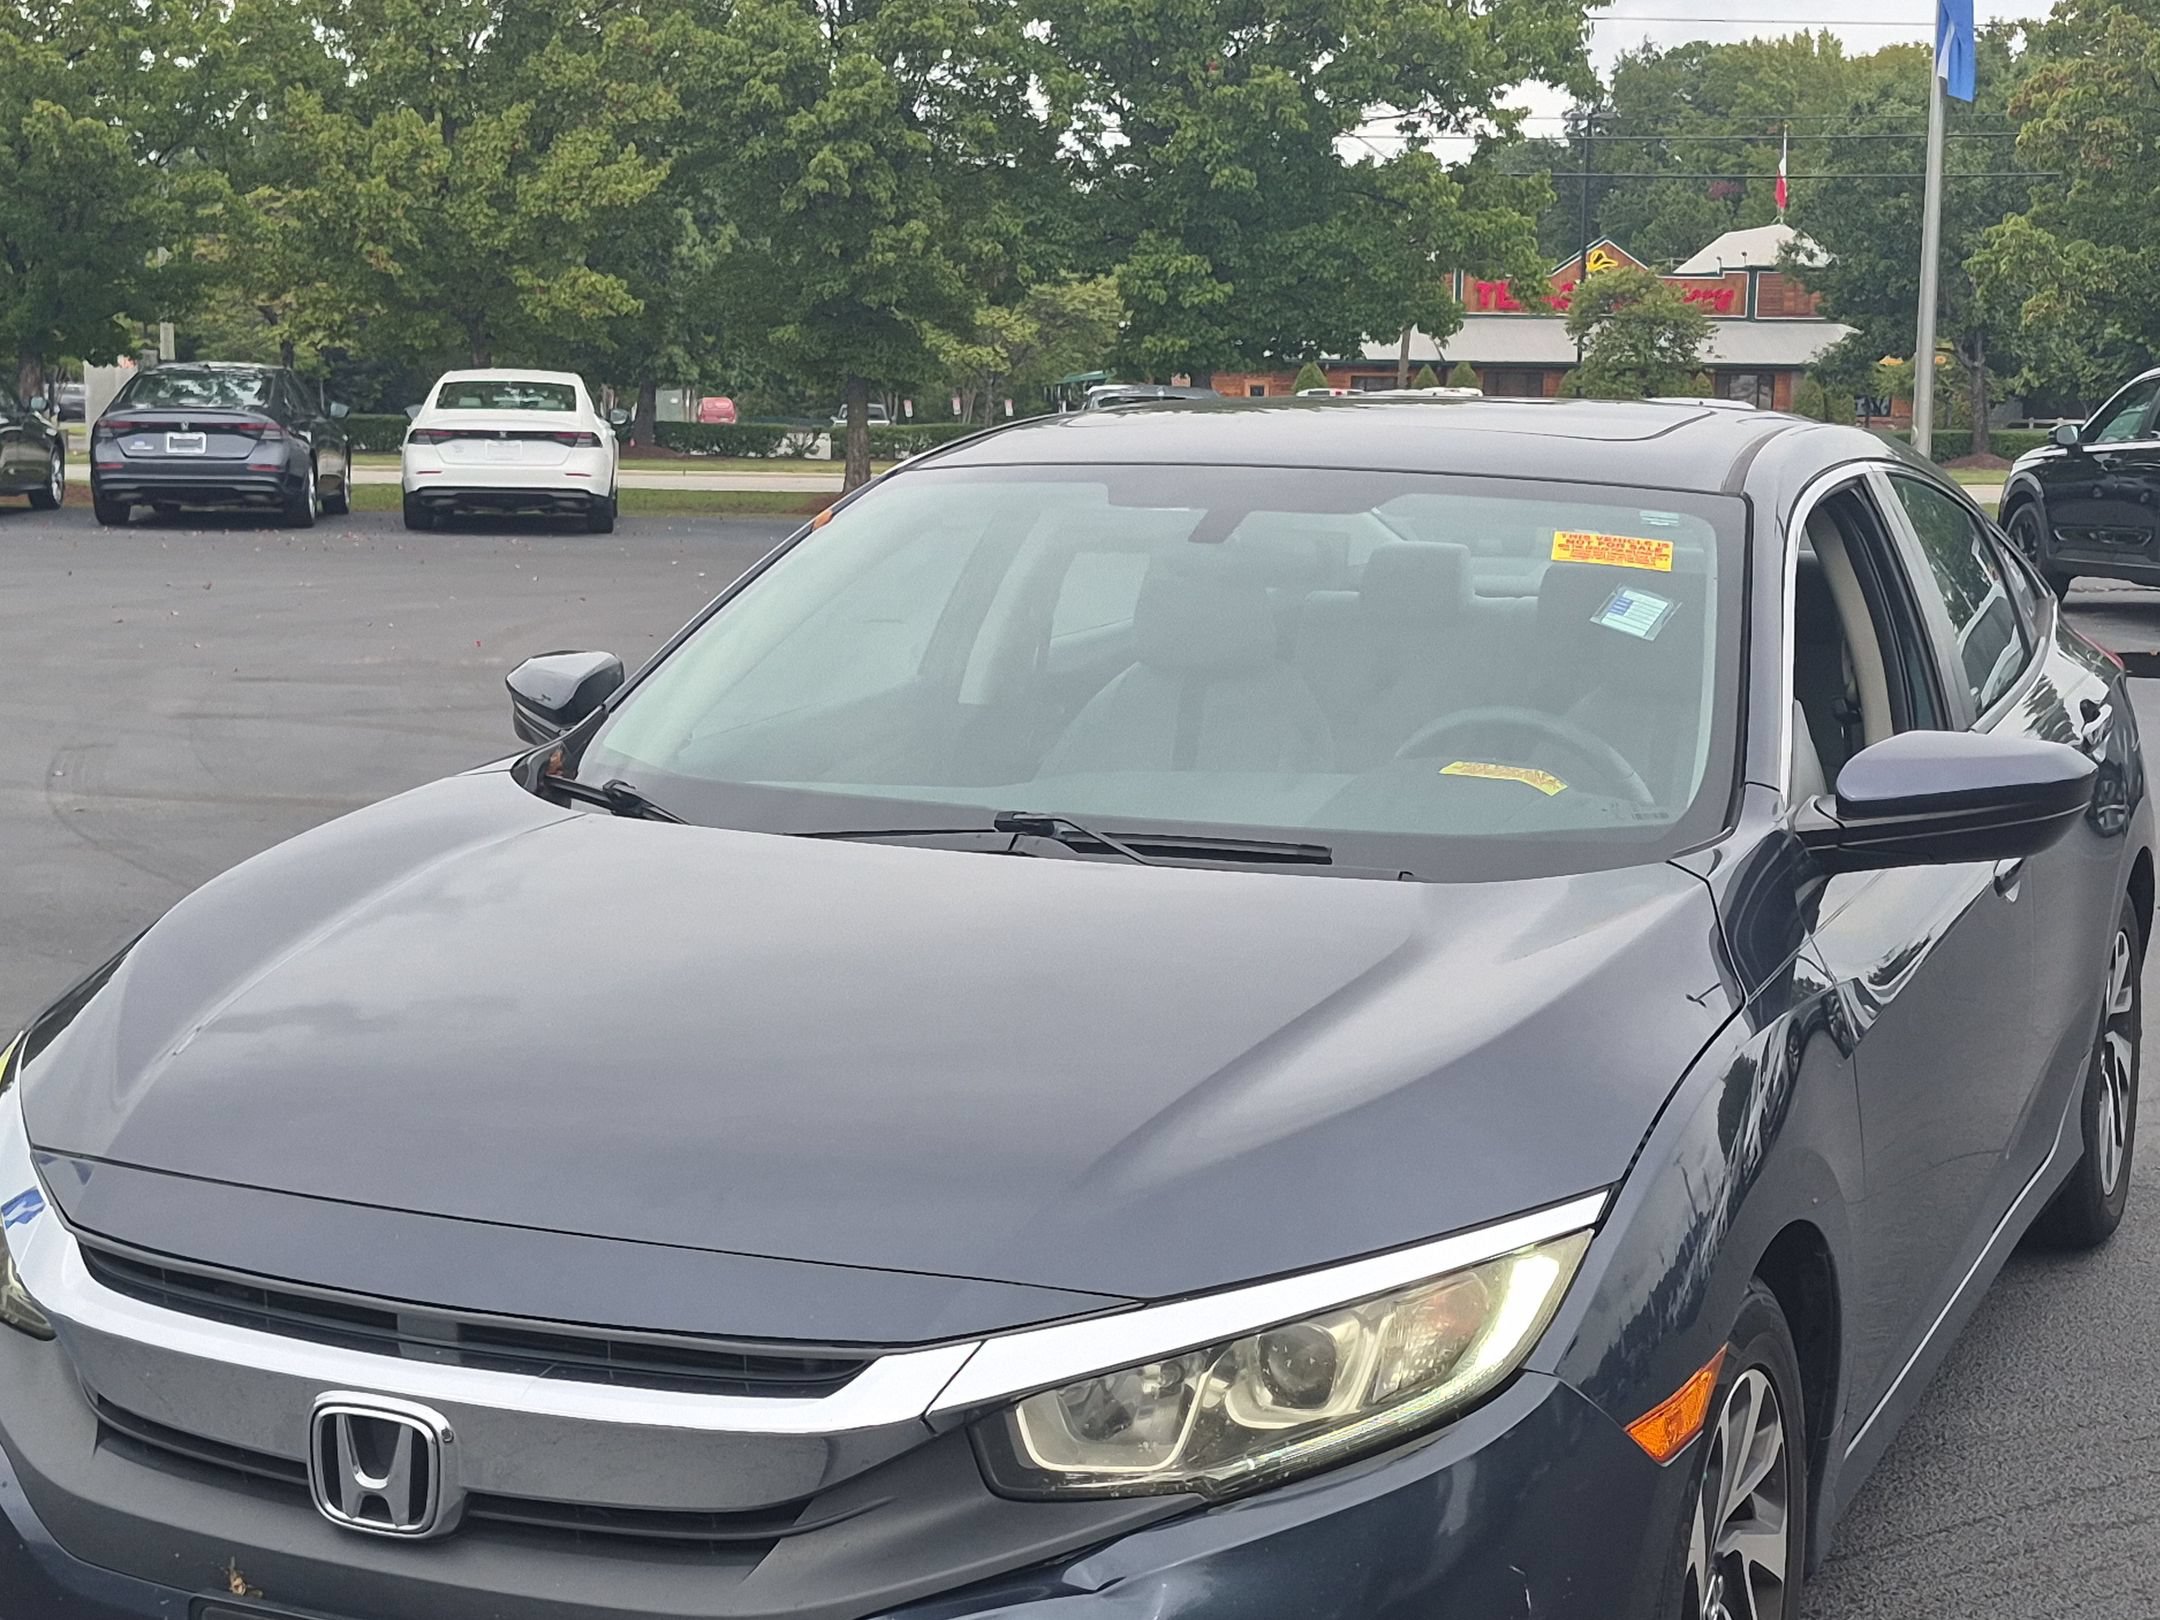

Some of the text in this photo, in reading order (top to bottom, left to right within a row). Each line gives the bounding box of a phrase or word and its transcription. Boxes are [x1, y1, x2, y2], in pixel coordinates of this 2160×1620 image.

[1562, 533, 1591, 541] THIS
[1596, 535, 1653, 545] VEHICLE
[1598, 541, 1625, 549] FOR
[1629, 544, 1663, 553] SALE
